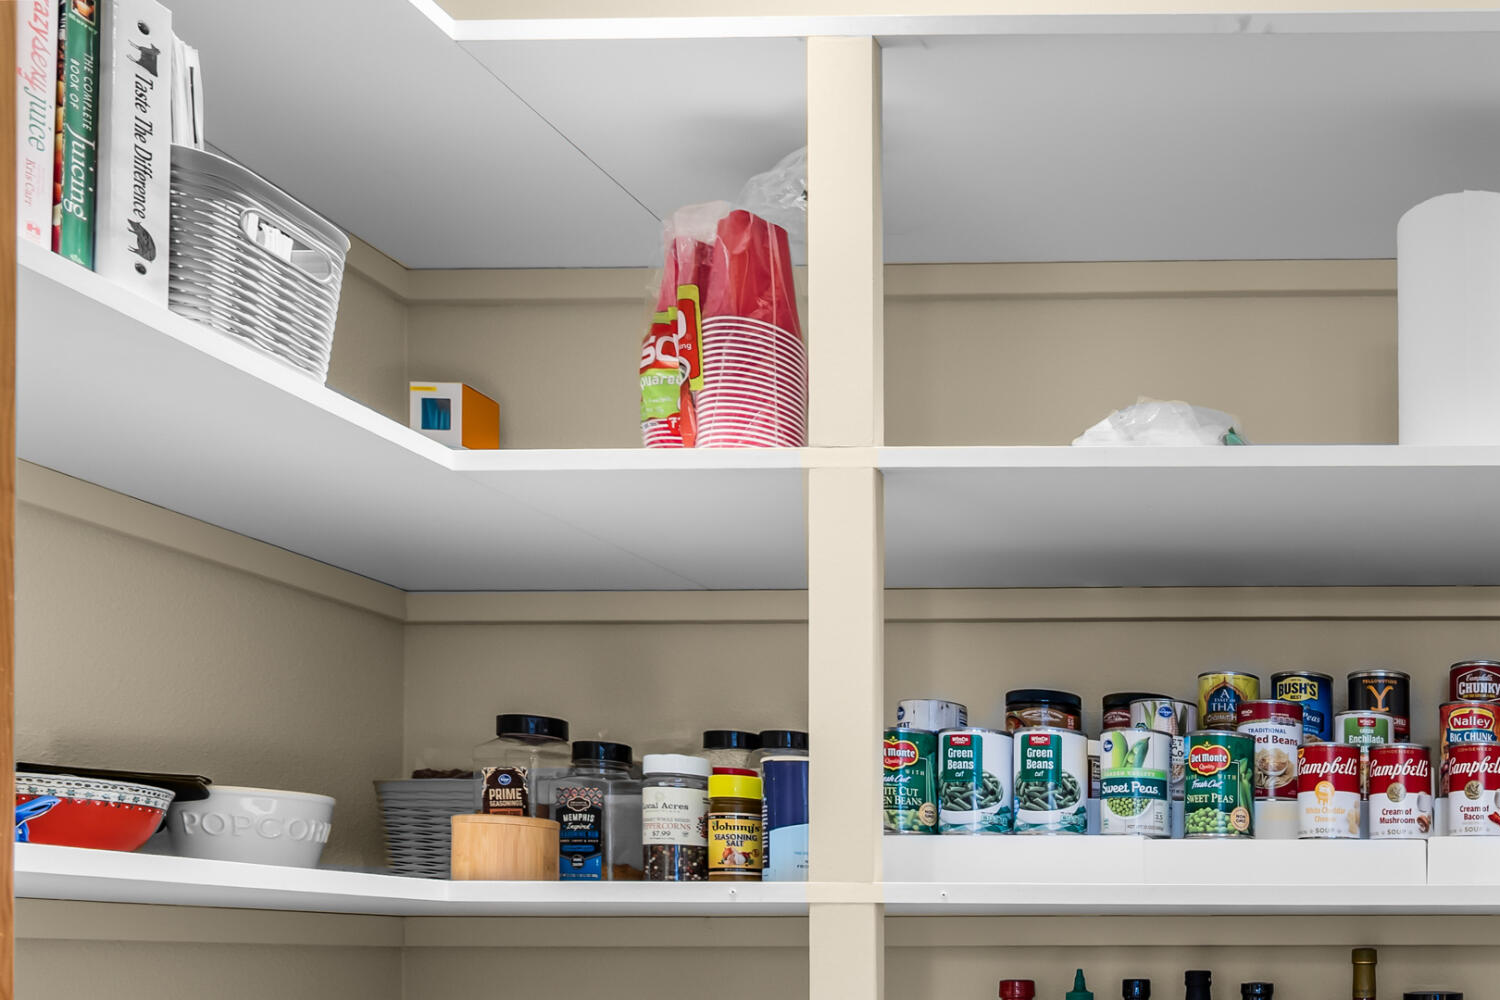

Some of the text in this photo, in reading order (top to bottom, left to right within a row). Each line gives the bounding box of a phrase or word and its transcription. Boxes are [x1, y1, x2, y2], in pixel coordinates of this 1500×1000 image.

[69, 58, 81, 110] BOOK OF
[82, 52, 94, 131] THE COMPLETE
[132, 73, 154, 219] Taste The Difference
[63, 123, 96, 221] Juicing
[1278, 681, 1319, 699] BUSH'S
[1452, 716, 1491, 728] Nalley
[1271, 735, 1298, 746] Beans
[1348, 734, 1385, 745] Enchilada
[1449, 731, 1494, 743] BIG CHUNK
[887, 747, 916, 759] Monte
[947, 748, 974, 759] Green
[1026, 747, 1053, 759] Green
[1191, 750, 1228, 763] Del Monte
[947, 758, 974, 770] Beans
[1026, 758, 1054, 770] Beans
[1298, 755, 1357, 779] Campbell's
[1369, 756, 1429, 779] Campbell's
[899, 787, 919, 797] CUT
[1101, 780, 1159, 795] Sweet Peas
[488, 787, 523, 801] PRIME
[1186, 792, 1234, 805] SWEET PEAS
[661, 801, 689, 810] Acres
[894, 796, 923, 807] BEANS
[1382, 807, 1412, 816] Cream of
[562, 813, 595, 823] MEMPHIS
[1379, 817, 1416, 826] Mushroom
[712, 819, 761, 834] Johnny's
[714, 833, 758, 841] SEASONING
[726, 839, 744, 848] SALT
